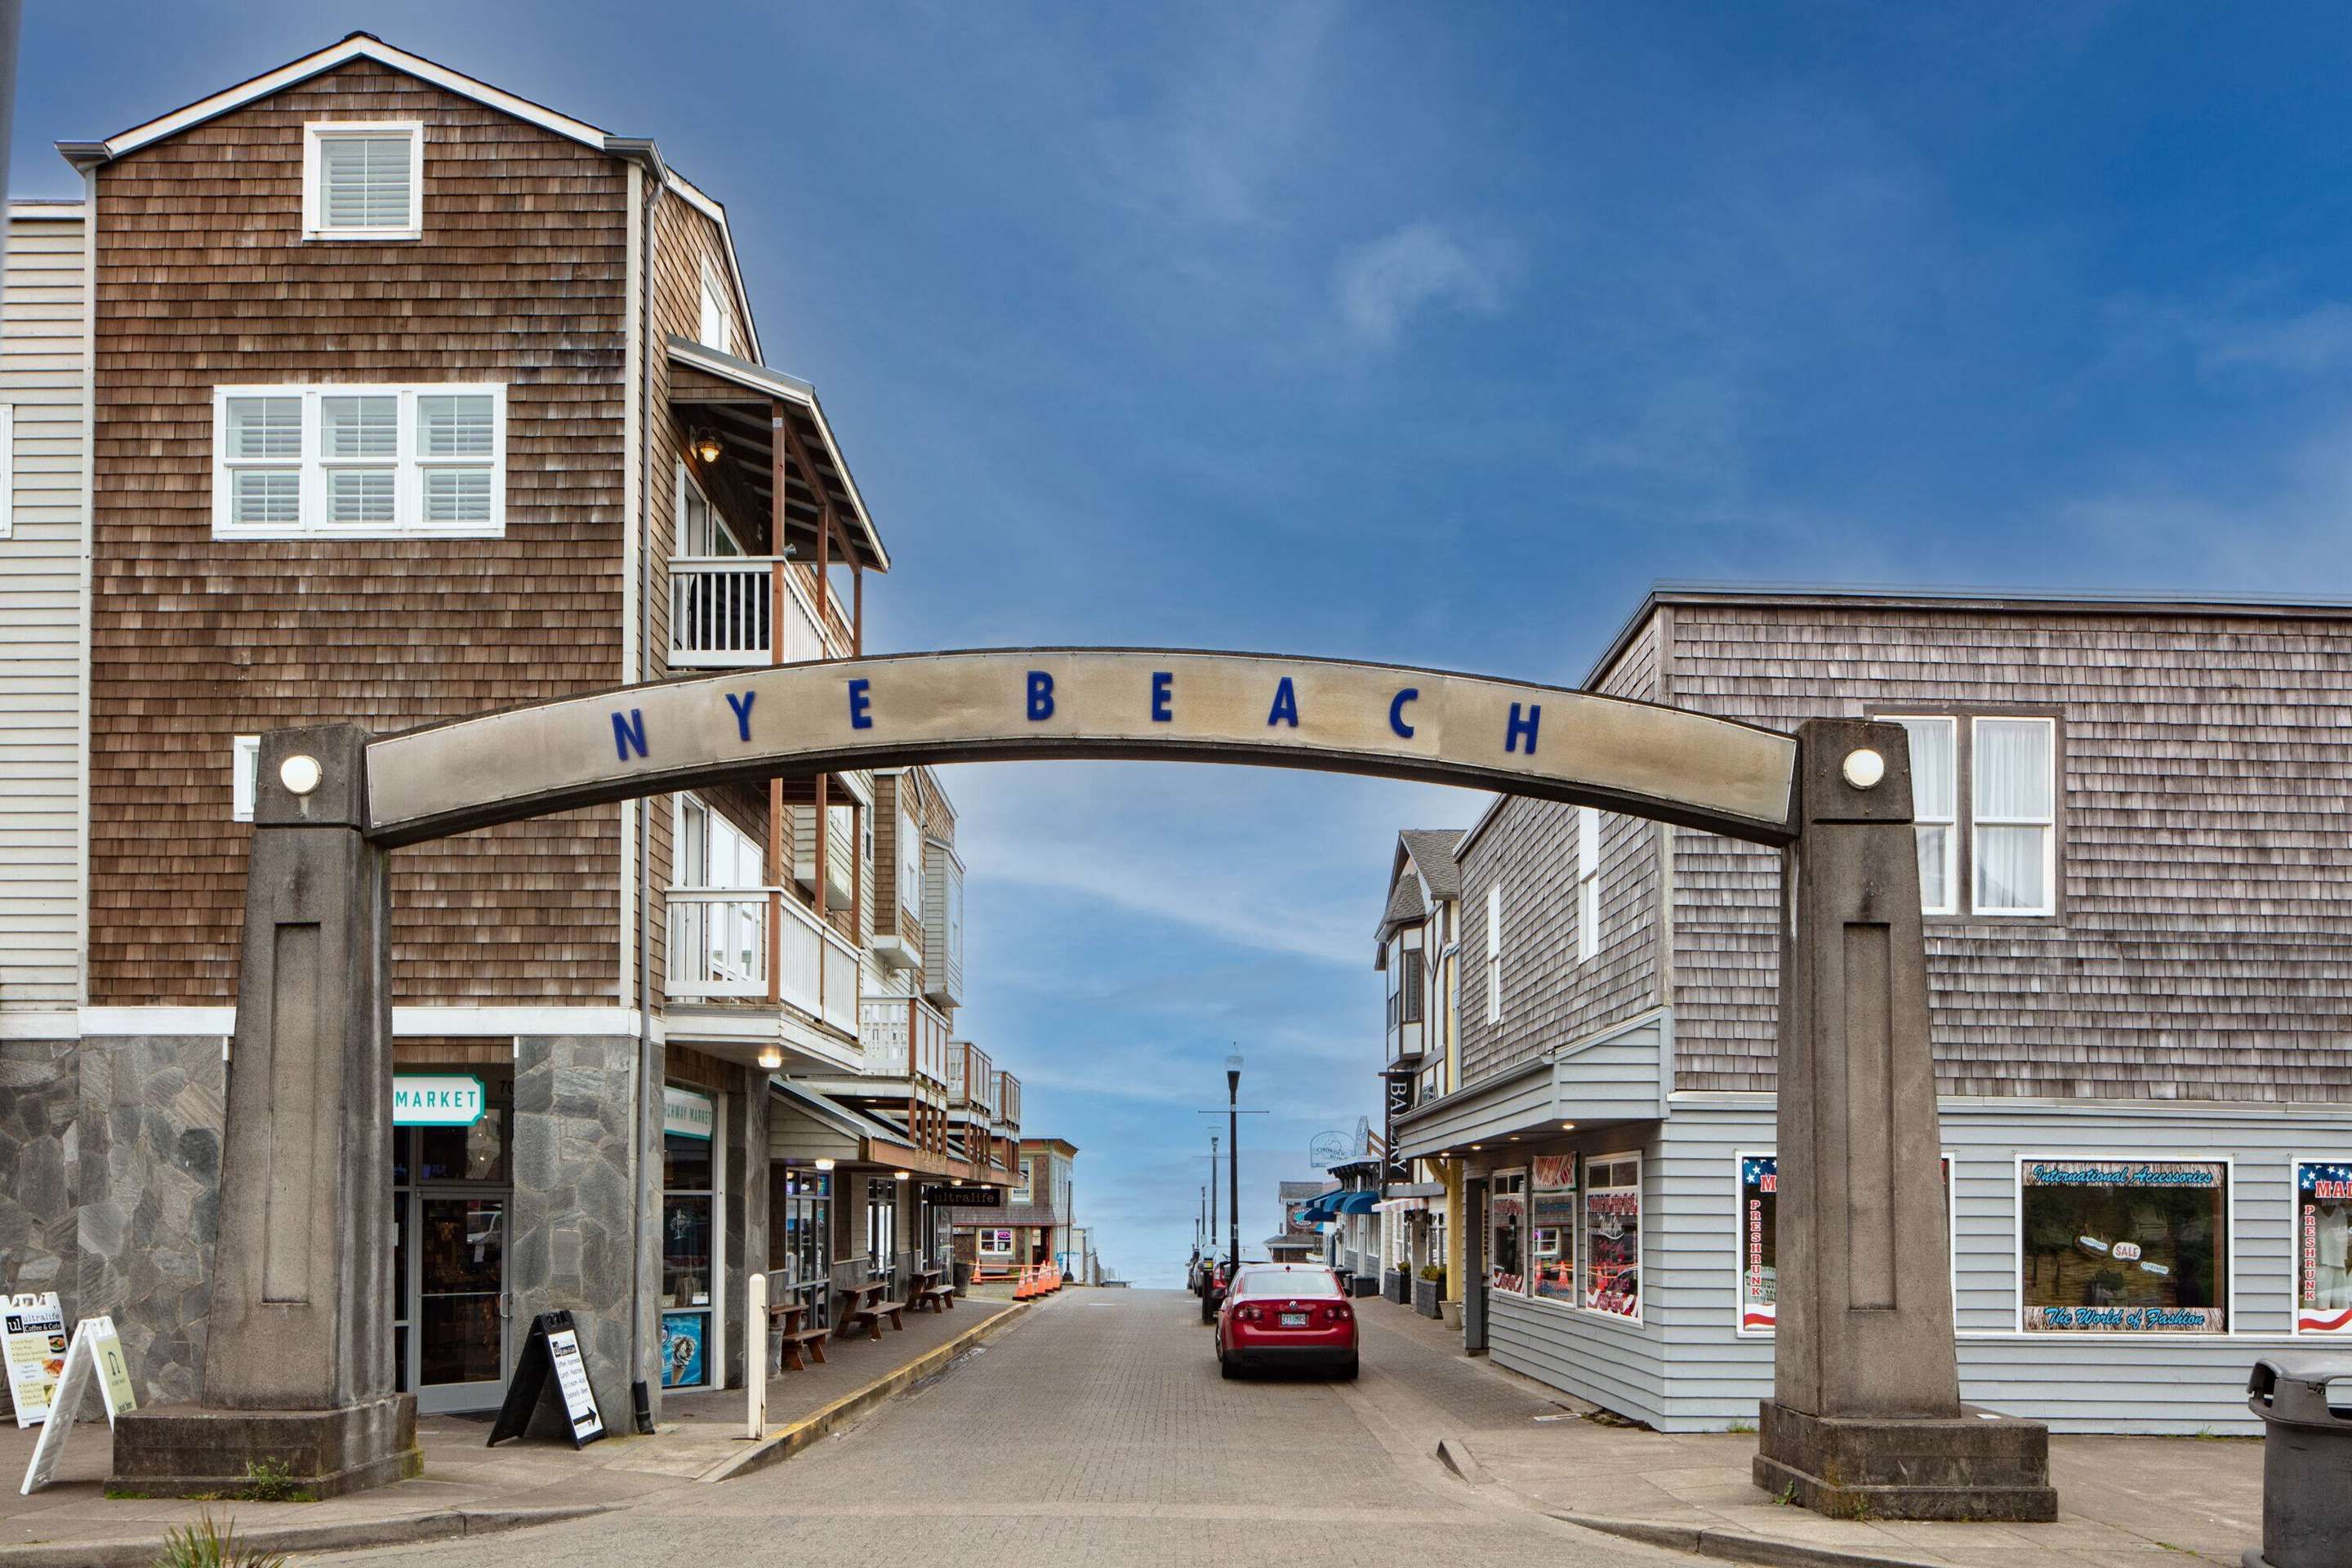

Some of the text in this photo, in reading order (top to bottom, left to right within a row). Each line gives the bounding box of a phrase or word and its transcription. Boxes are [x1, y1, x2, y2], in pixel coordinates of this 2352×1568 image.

[612, 670, 1541, 760] NYE BEACH
[395, 1091, 476, 1107] MARKET
[689, 1107, 711, 1125] MARKET
[2033, 1165, 2213, 1183] International Accessories
[933, 1192, 995, 1203] ultralife
[1750, 1200, 1761, 1296] PRESHRUNK
[2115, 1245, 2138, 1257] SALE
[2305, 1205, 2315, 1300] PRESHRUNK
[23, 1312, 60, 1323] ultralife
[2044, 1307, 2205, 1330] The World of Fashion
[24, 1325, 42, 1333] Coffee
